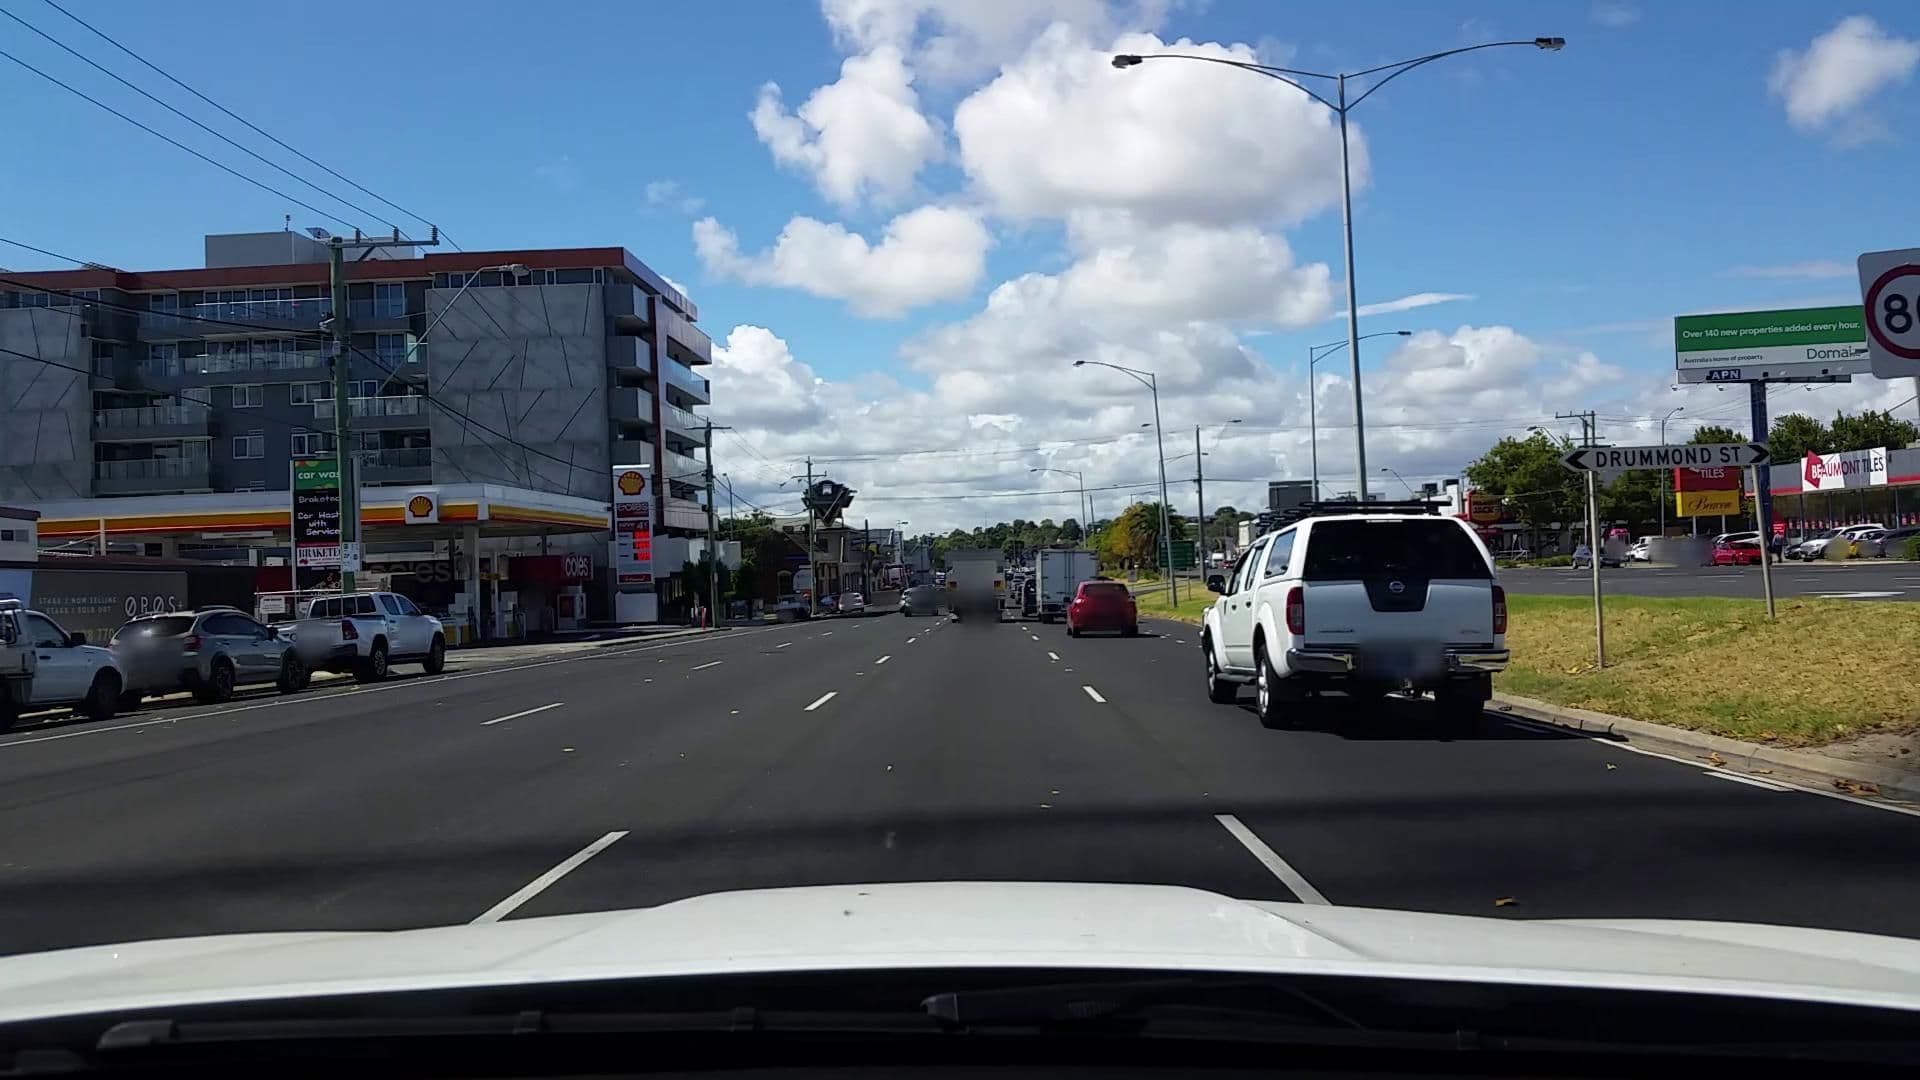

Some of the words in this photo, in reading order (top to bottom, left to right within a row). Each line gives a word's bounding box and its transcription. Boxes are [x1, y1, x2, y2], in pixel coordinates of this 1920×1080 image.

[1884, 293, 1920, 334] 8
[1682, 330, 1702, 339] Over
[1704, 329, 1719, 337] 140
[1721, 329, 1738, 337] new
[1739, 325, 1783, 337] properties
[1785, 323, 1812, 333] added
[1813, 322, 1837, 332] every
[1839, 321, 1861, 330] hour.
[1711, 370, 1740, 380] APN
[1597, 450, 1712, 467] DRUMMOND
[1719, 446, 1742, 464] ST
[1811, 460, 1861, 479] BEAUMONT
[1862, 456, 1884, 473] TILES
[298, 471, 315, 480] car
[318, 470, 340, 479] was
[1700, 468, 1725, 479] TILES
[297, 512, 313, 520] Car
[308, 519, 327, 528] with
[299, 548, 341, 558] BRAKETE
[565, 554, 588, 577] coles
